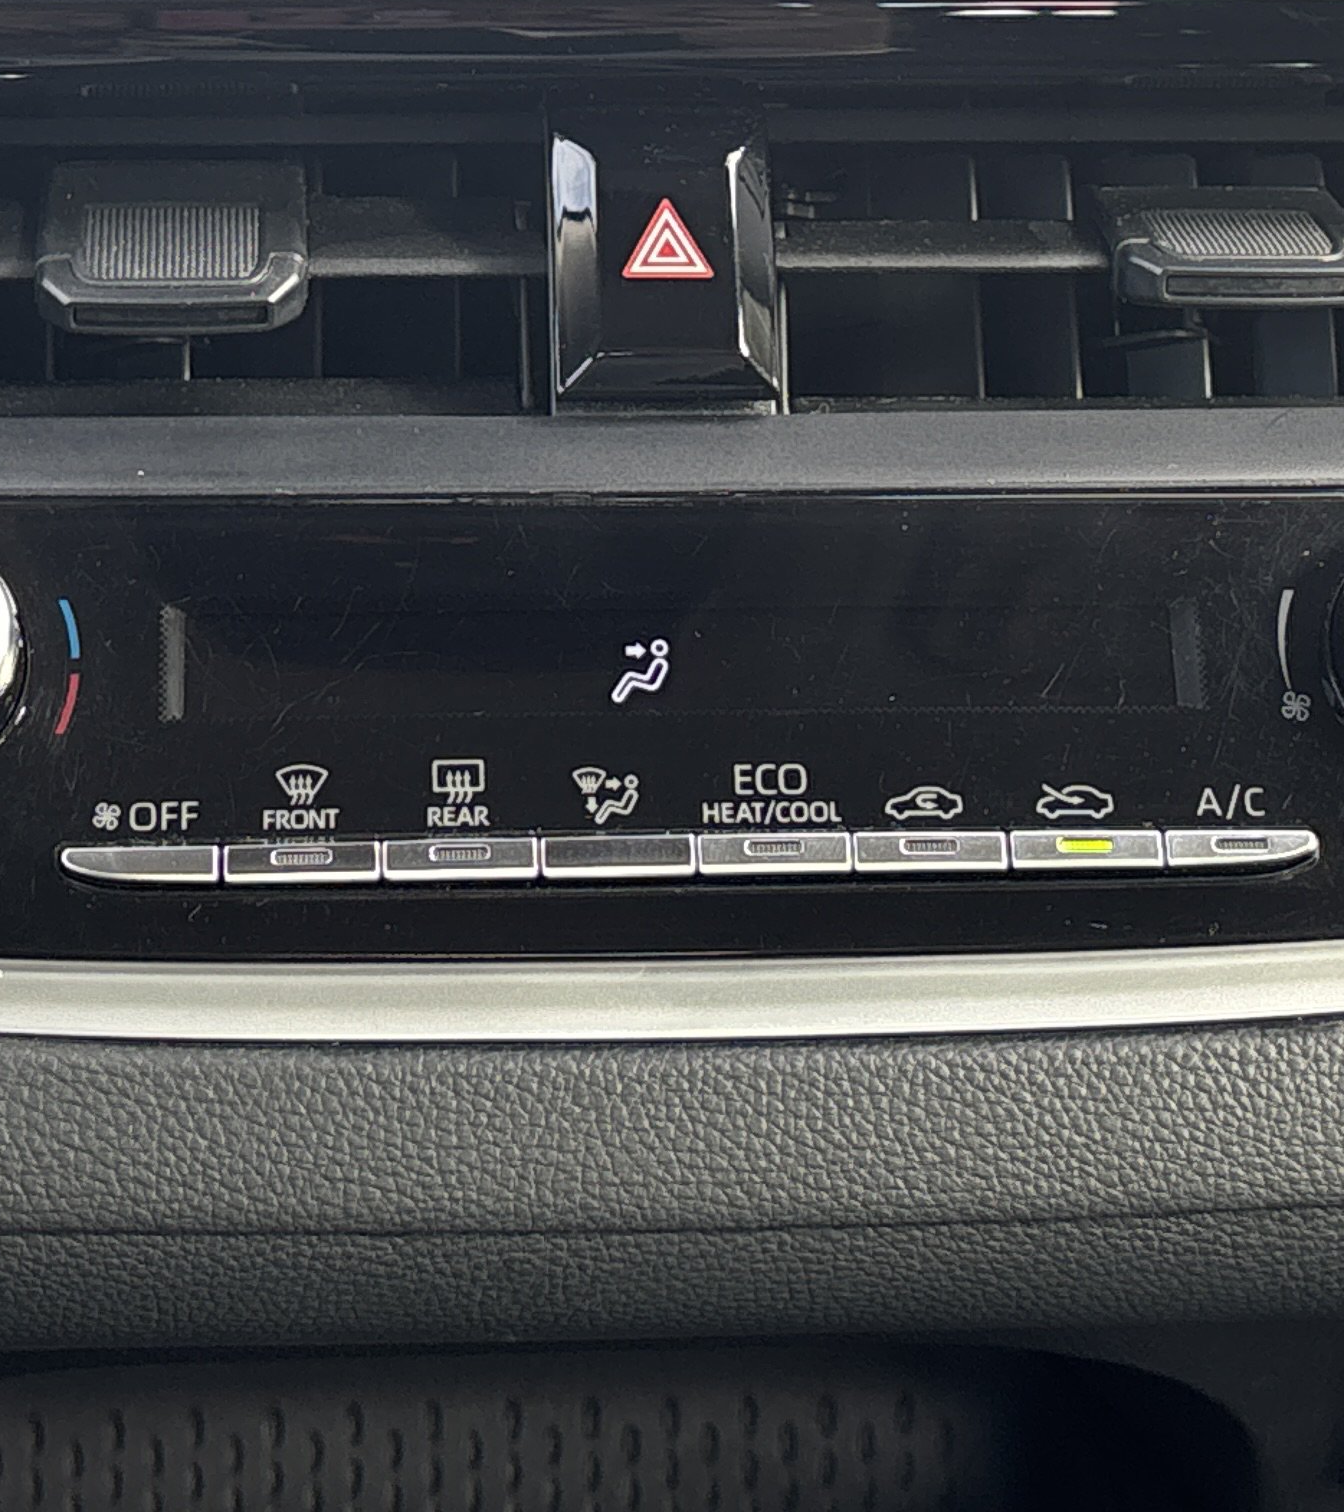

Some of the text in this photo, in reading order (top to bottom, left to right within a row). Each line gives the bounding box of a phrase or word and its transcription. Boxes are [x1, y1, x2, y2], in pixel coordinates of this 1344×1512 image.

[733, 763, 808, 797] ECO
[128, 801, 199, 831] OFF
[701, 800, 843, 825] HEAT/COOL
[1196, 786, 1267, 819] A/C
[262, 808, 340, 831] FRONT
[426, 805, 490, 829] REAR
